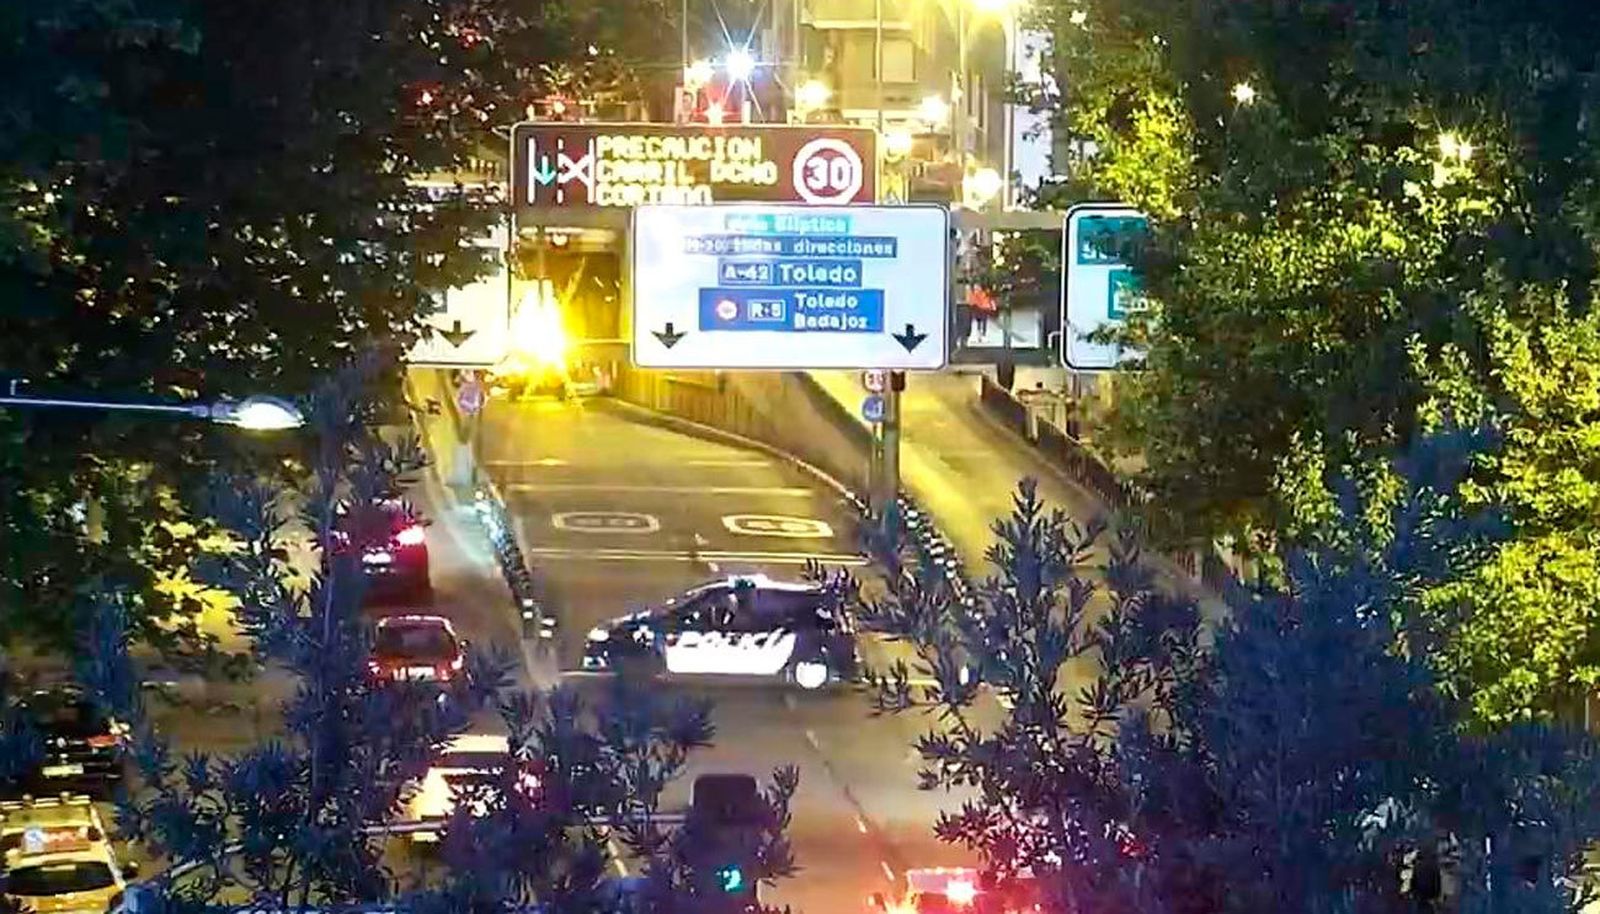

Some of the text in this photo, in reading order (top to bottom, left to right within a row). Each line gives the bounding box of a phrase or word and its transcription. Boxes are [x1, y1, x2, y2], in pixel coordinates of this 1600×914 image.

[597, 136, 761, 161] PRECAUCION
[597, 161, 694, 184] CARRIL
[806, 157, 850, 190] 30
[794, 240, 893, 255] direcciones
[724, 264, 857, 282] A-42 Toledo
[751, 302, 782, 318] R-5
[794, 293, 858, 309] Toledo
[794, 313, 867, 331] Badajoz
